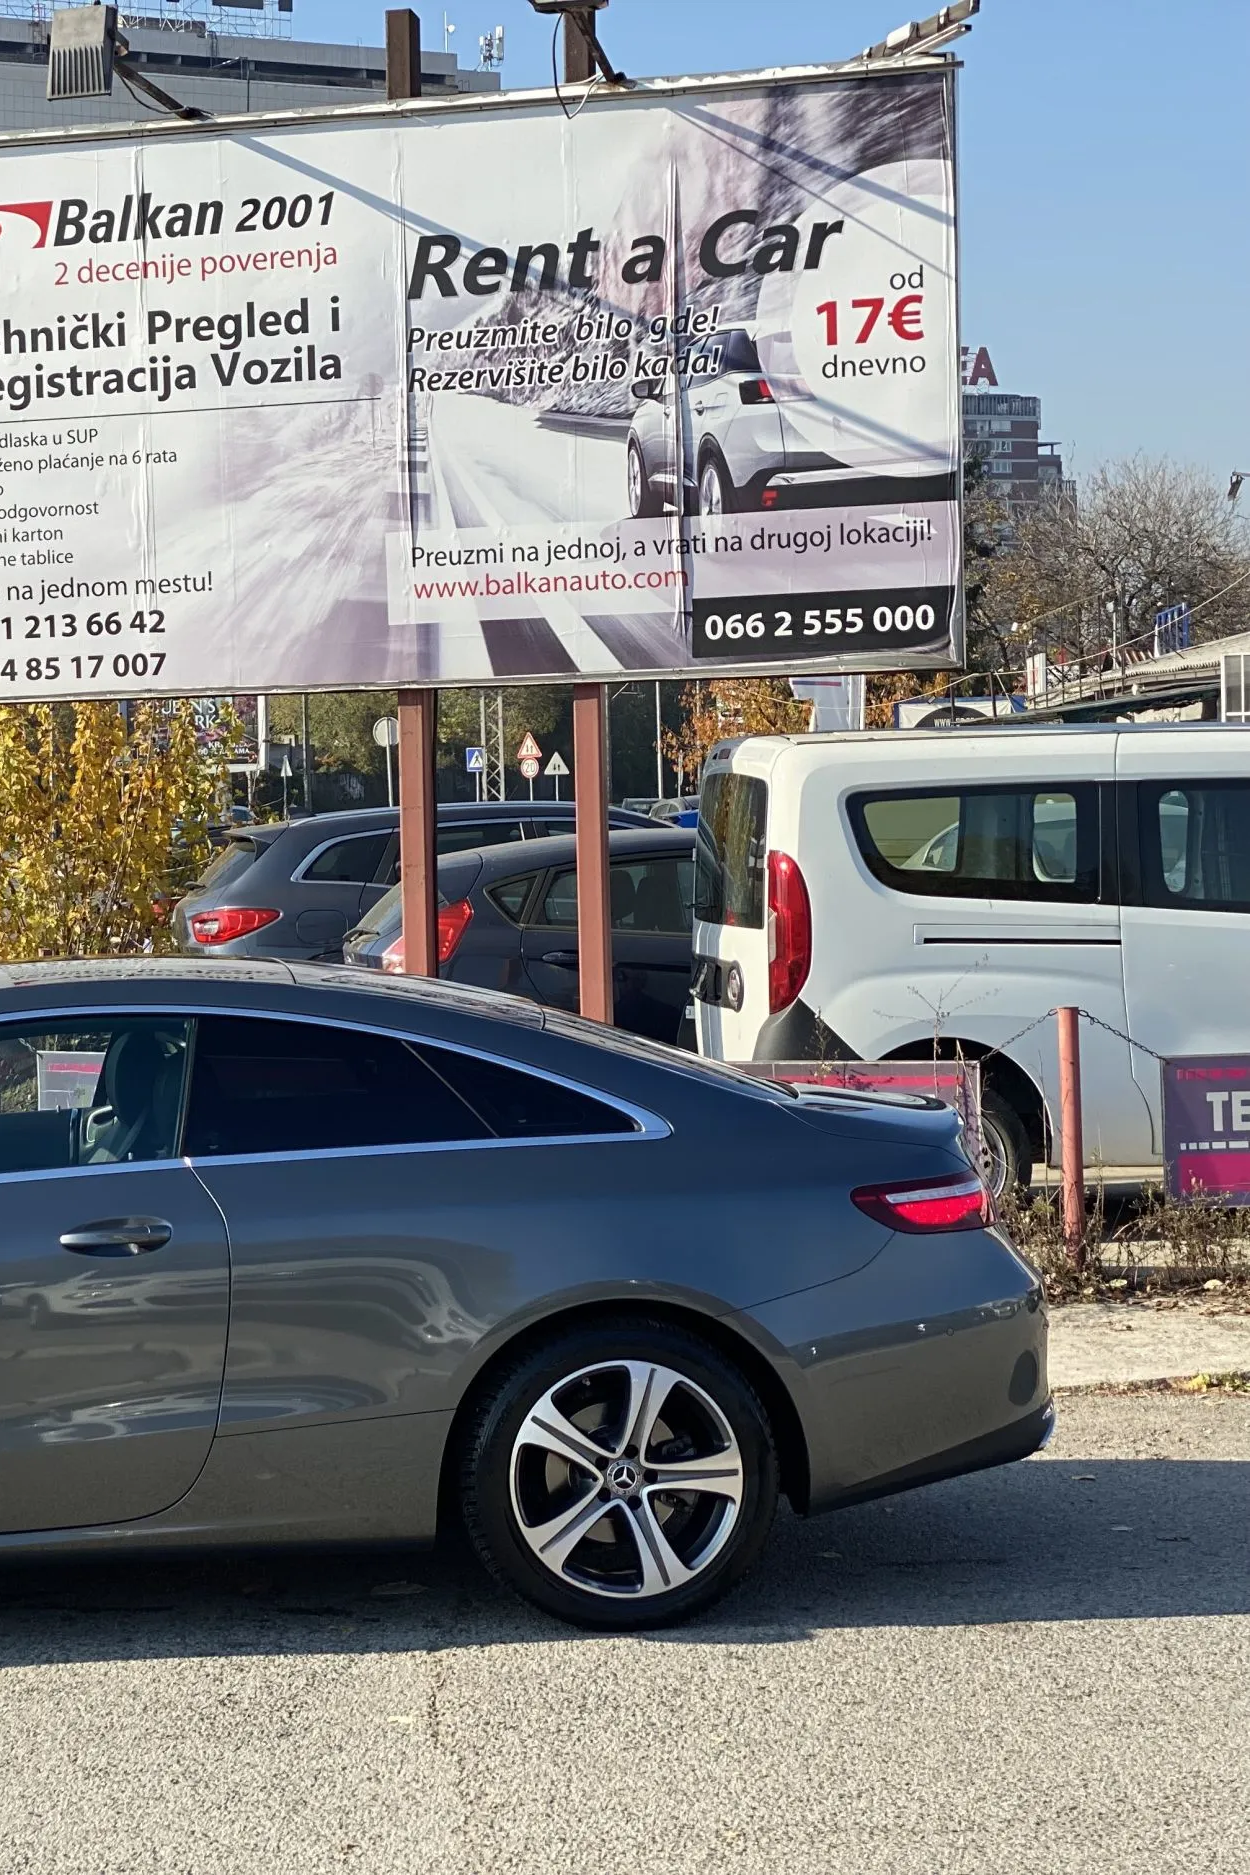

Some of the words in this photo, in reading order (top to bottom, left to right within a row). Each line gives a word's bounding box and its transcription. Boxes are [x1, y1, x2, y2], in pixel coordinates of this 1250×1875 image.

[53, 193, 223, 248] Balkan
[235, 191, 335, 233] 2001
[54, 263, 69, 285] 2
[77, 255, 192, 285] decenije
[201, 243, 338, 280] poverenja
[407, 226, 601, 300] Rent
[622, 235, 665, 285] a
[698, 209, 844, 277] Car
[889, 265, 925, 290] od
[147, 298, 310, 352] Pregled
[330, 296, 340, 333] i
[407, 318, 559, 353] Preuzmite
[575, 311, 634, 342] bilo
[649, 306, 721, 346] gde!
[815, 294, 925, 346] 17€
[211, 345, 343, 387] Vozila
[407, 359, 563, 394] Rezervišite
[571, 355, 627, 382] bilo
[633, 346, 721, 378] kada!
[820, 353, 926, 379] dnevno
[52, 433, 63, 444] u
[67, 428, 98, 444] SUP
[38, 451, 106, 476] plaćanje
[110, 454, 128, 466] na
[132, 450, 142, 465] 6
[146, 449, 178, 465] rata
[12, 525, 64, 542] karton
[411, 542, 504, 567] Preuzmi
[511, 545, 539, 563] na
[545, 536, 629, 567] jednoj,
[633, 541, 647, 557] a
[652, 532, 707, 556] vrati
[714, 534, 743, 553] na
[749, 525, 832, 553] drugoj
[839, 518, 932, 548] lokaciji!
[20, 548, 74, 566] tablice
[6, 584, 34, 600] na
[39, 578, 128, 605] jednom
[135, 571, 214, 596] mestu!
[412, 565, 690, 599] www.balkanauto.com
[24, 615, 78, 639] 213
[86, 613, 123, 636] 66
[129, 610, 166, 634] 42
[704, 612, 764, 641] 066
[774, 610, 793, 636] 2
[803, 607, 862, 634] 555
[871, 603, 935, 631] 000
[25, 658, 61, 681] 85
[71, 655, 105, 679] 17
[112, 653, 167, 676] 007
[525, 762, 535, 773] 20
